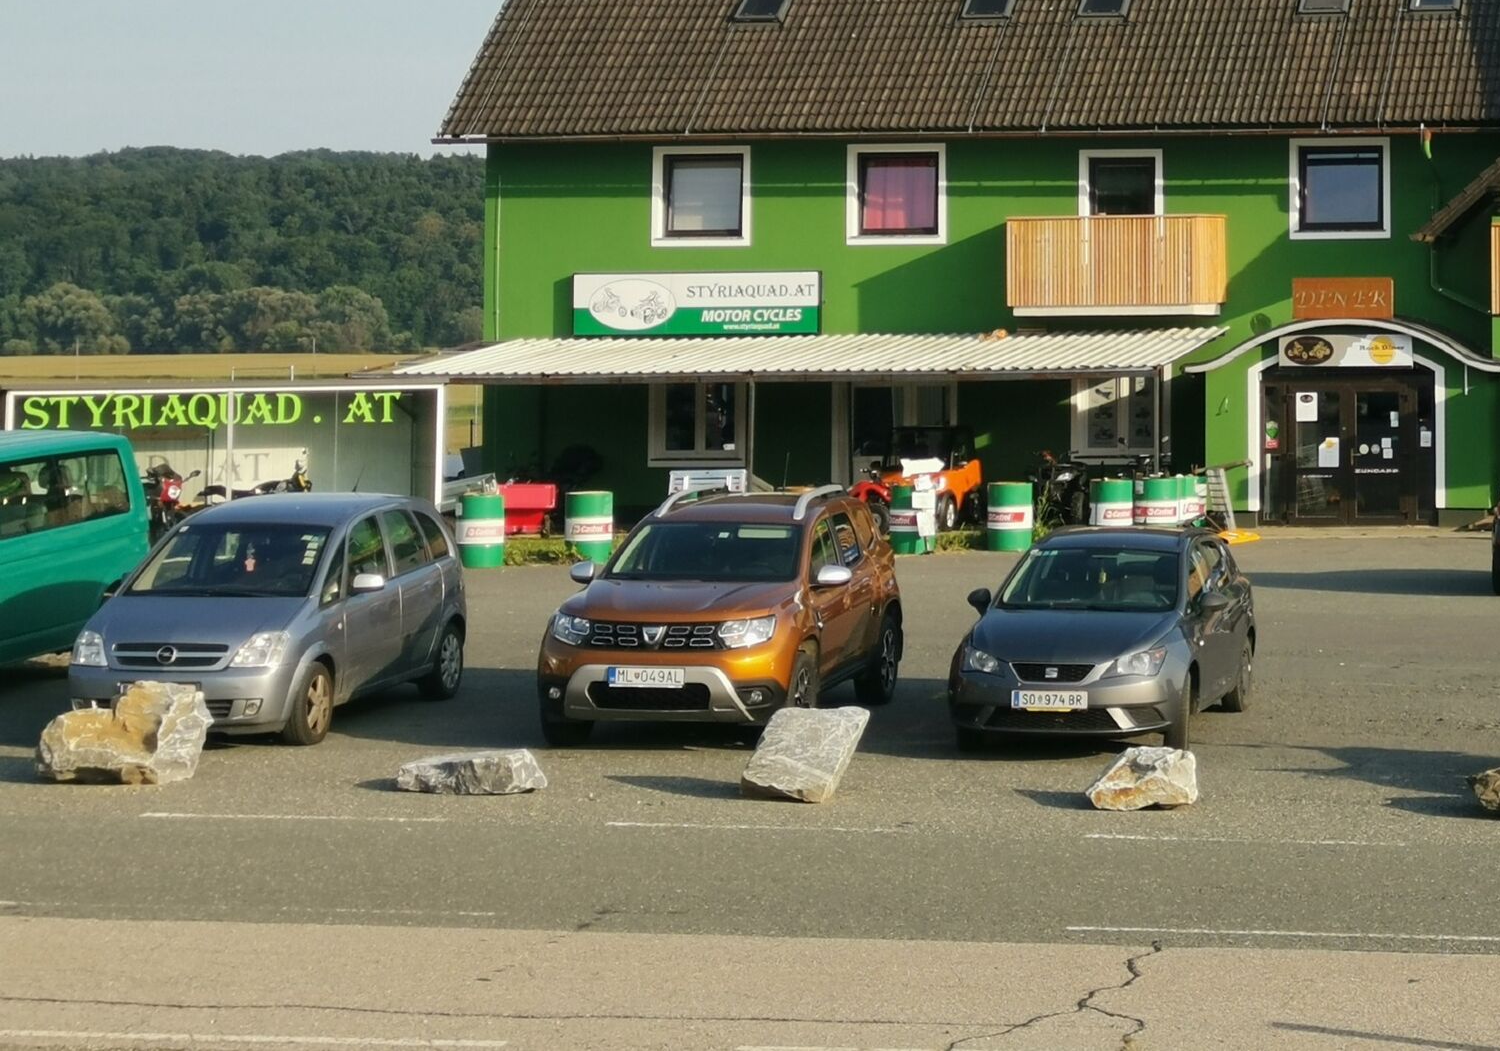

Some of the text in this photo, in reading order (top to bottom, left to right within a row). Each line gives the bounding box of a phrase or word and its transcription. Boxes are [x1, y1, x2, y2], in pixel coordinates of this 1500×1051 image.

[686, 283, 816, 299] STYRIAQUAD.AT
[1295, 290, 1386, 309] DINER
[701, 308, 802, 323] MOTOR CYCLES
[617, 668, 633, 683] ML
[1044, 693, 1065, 706] 974
[1068, 694, 1083, 706] BR
